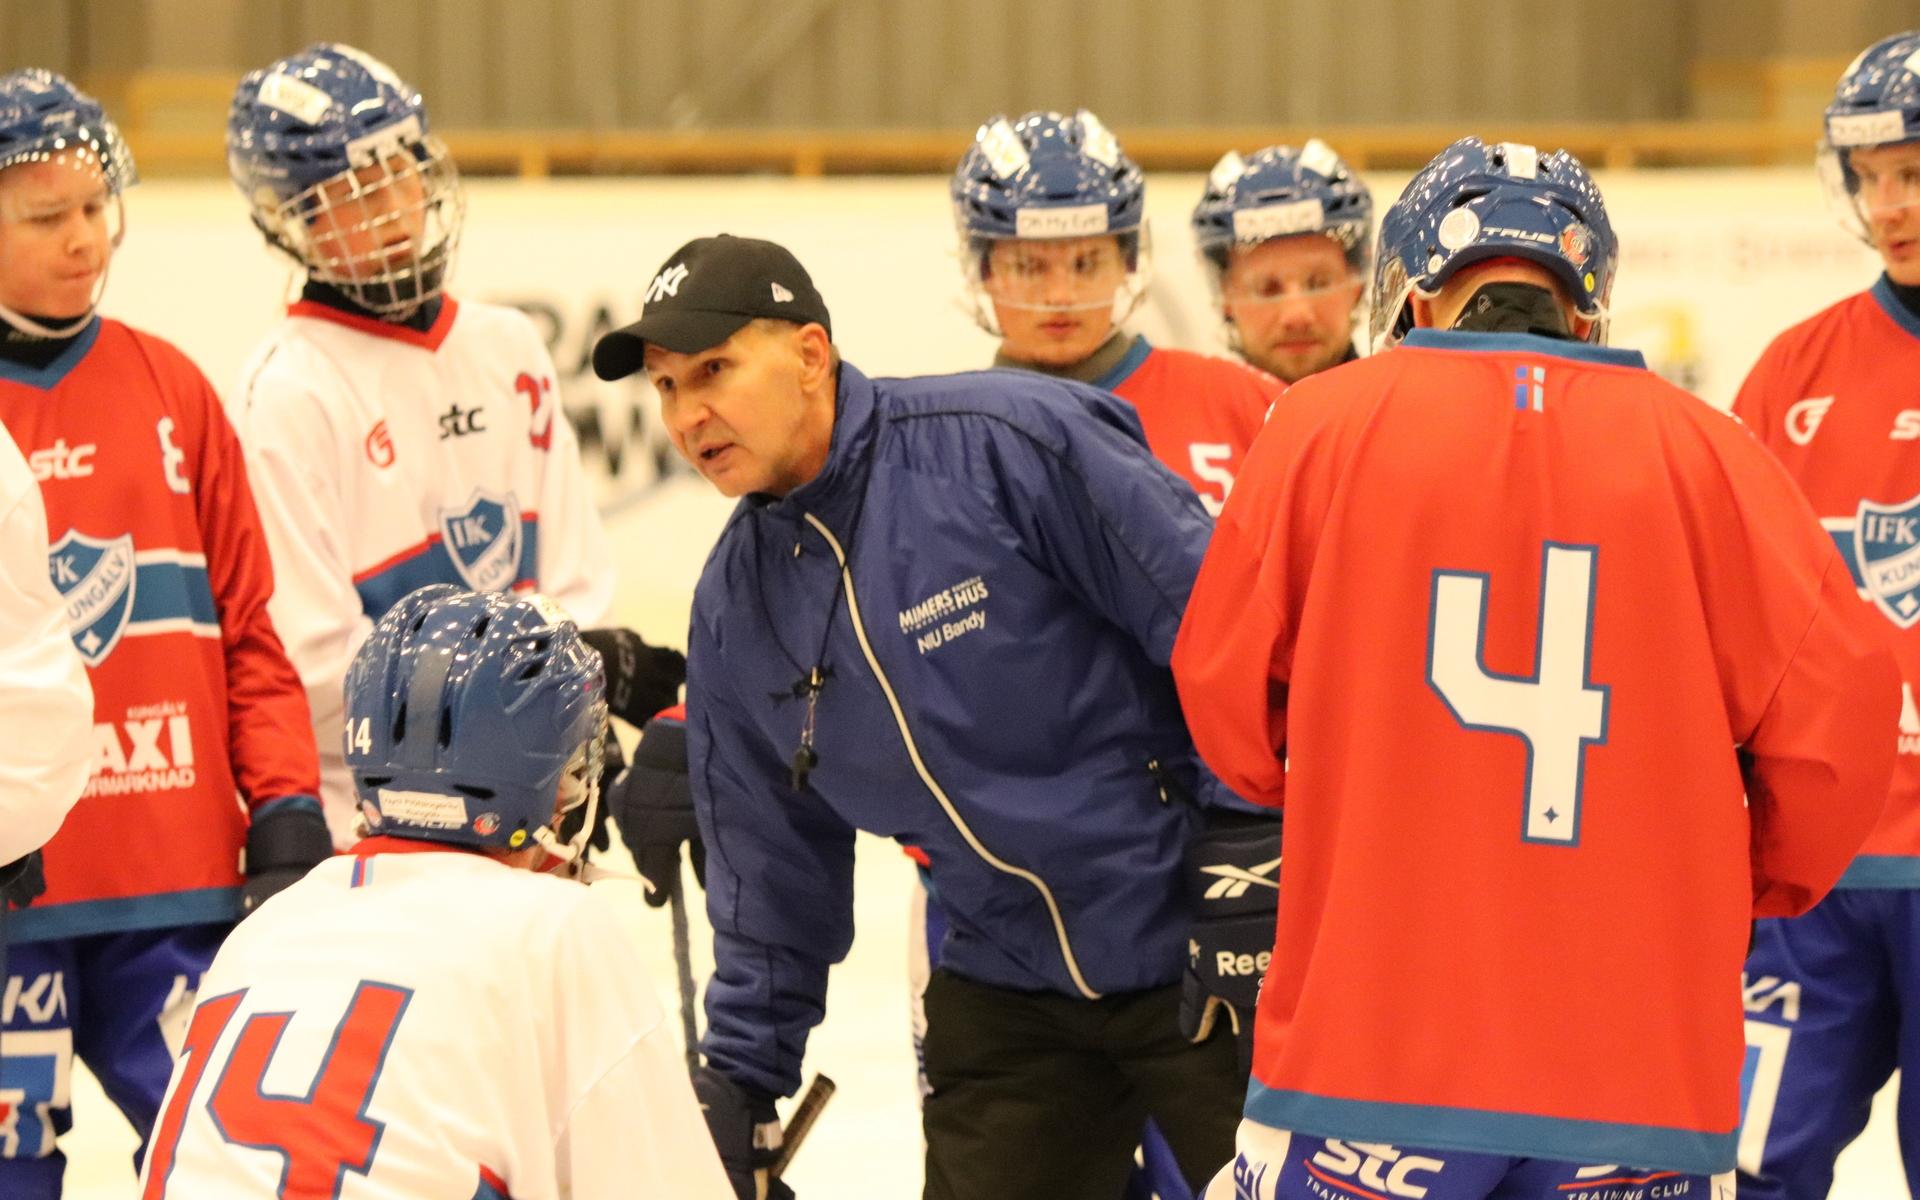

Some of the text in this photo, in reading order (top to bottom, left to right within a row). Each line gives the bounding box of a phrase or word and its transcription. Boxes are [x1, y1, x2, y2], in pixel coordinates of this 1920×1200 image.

[439, 404, 487, 440] stc
[30, 439, 97, 482] stc
[1188, 443, 1236, 518] 5
[1866, 514, 1919, 544] IFK
[899, 580, 989, 629] MIMERS HUS
[917, 610, 985, 655] NIU Bandy
[1425, 540, 1612, 848] 4
[345, 717, 372, 755] 14
[1216, 951, 1272, 977] Ree
[142, 979, 415, 1200] 14
[1312, 1138, 1446, 1199] stc
[1651, 1181, 1690, 1198] CLUB
